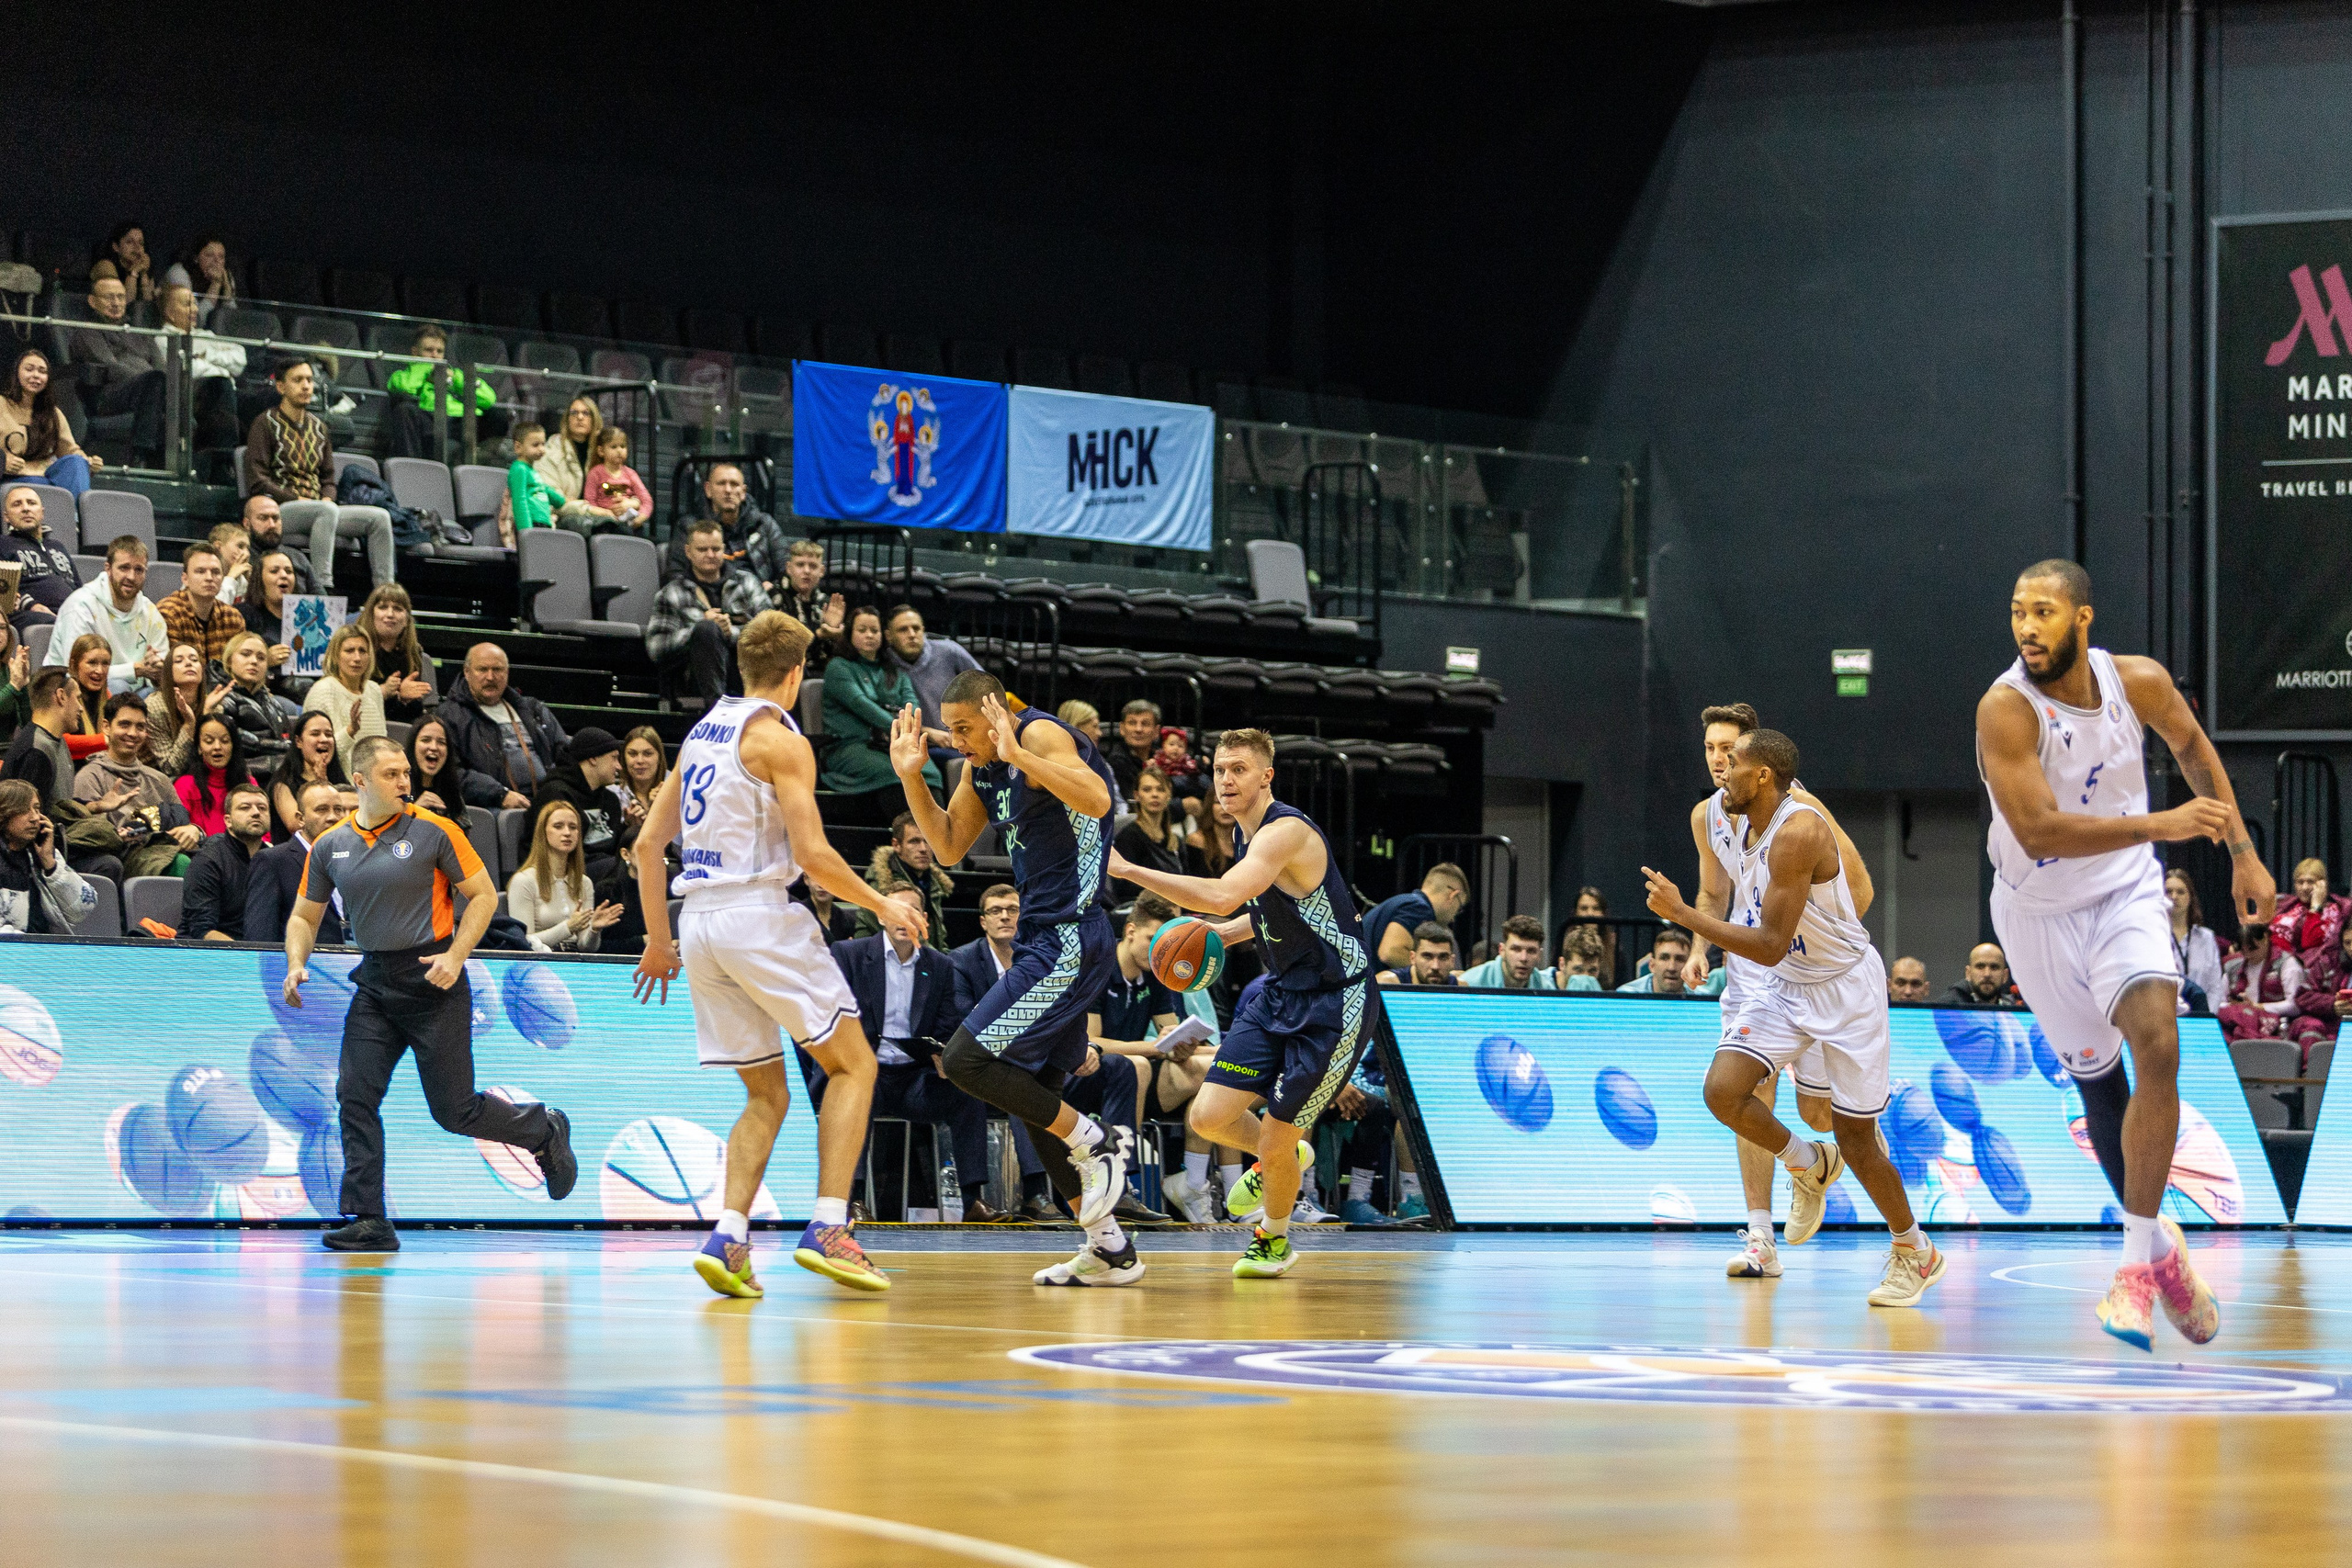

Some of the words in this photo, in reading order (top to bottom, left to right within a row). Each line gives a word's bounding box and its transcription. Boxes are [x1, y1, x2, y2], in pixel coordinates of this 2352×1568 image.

[2288, 374, 2352, 401] MAR
[2288, 412, 2352, 440] MIN
[2260, 480, 2328, 498] TRAVEL
[2276, 670, 2352, 690] MARRIOTT
[690, 722, 736, 744] SONKO
[682, 762, 716, 825] 13
[2081, 761, 2104, 806] 5
[1216, 1060, 1260, 1077] евроопт
